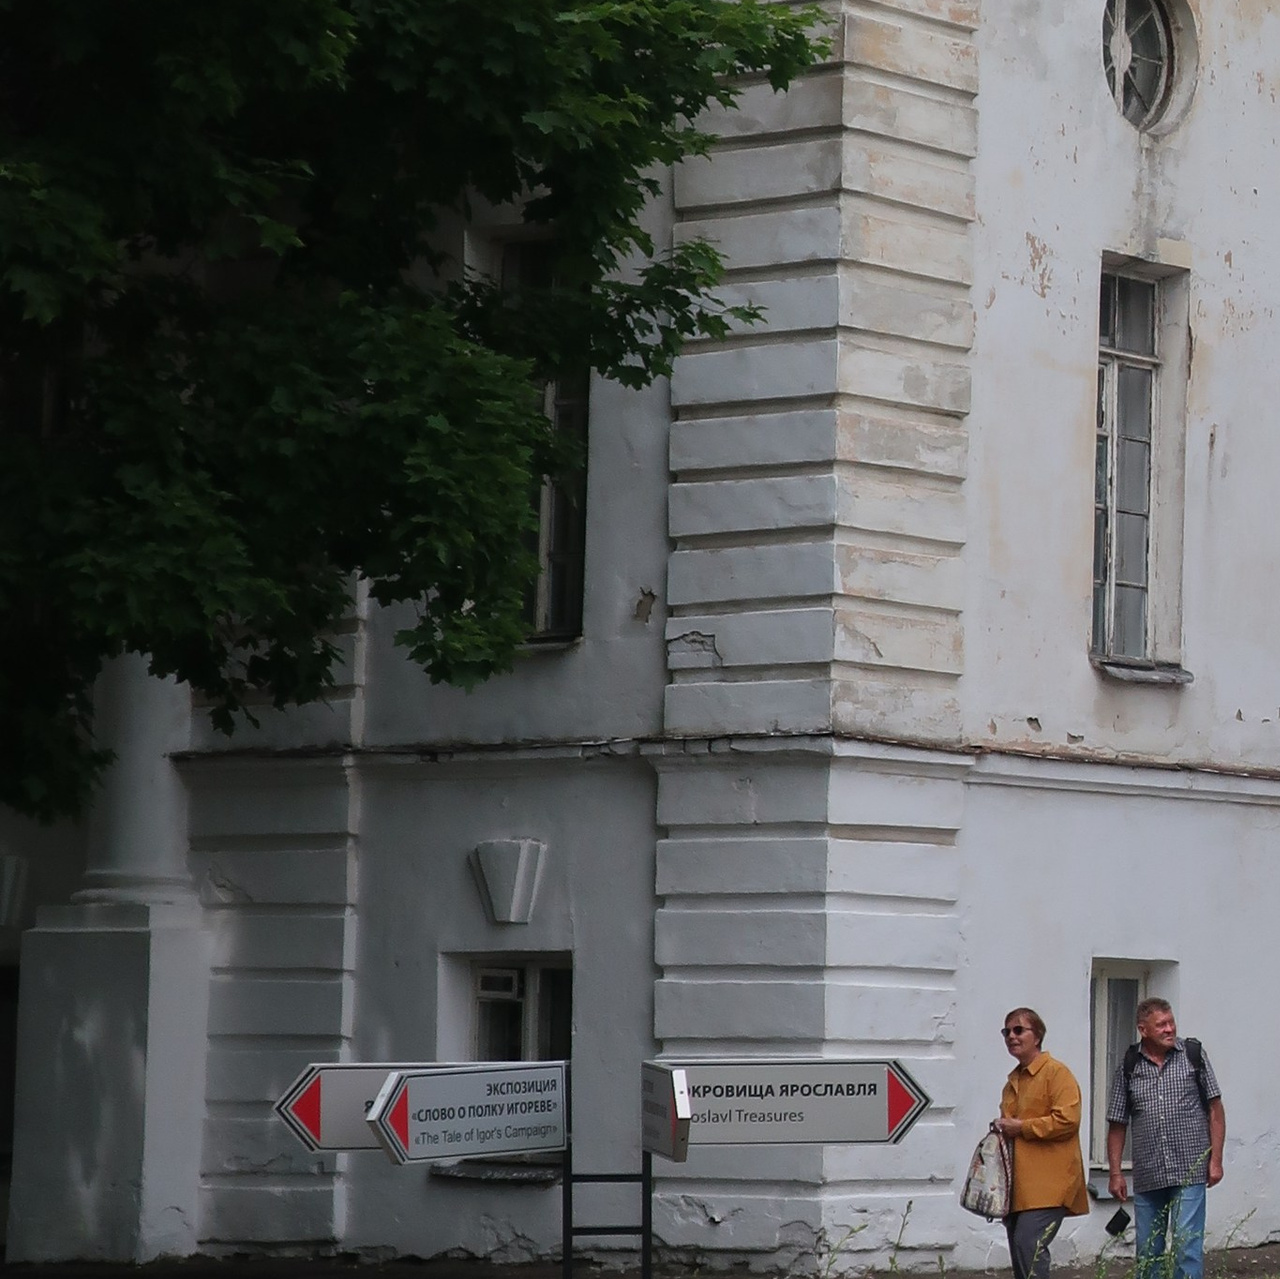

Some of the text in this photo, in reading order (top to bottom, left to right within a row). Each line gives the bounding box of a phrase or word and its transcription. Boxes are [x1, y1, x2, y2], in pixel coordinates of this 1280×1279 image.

[486, 1079, 557, 1096] ЭКСПОЗИЦИЯ
[779, 1083, 877, 1097] ЯРОСЛАВЛЯ
[411, 1100, 557, 1122] «СЛОВО О ПОЛКУ ИГОРЕВЕ»
[735, 1109, 804, 1123] Treasures
[415, 1131, 439, 1145] «The
[441, 1130, 461, 1143] Tale
[464, 1128, 474, 1142] of
[504, 1125, 558, 1139] Campaign»
